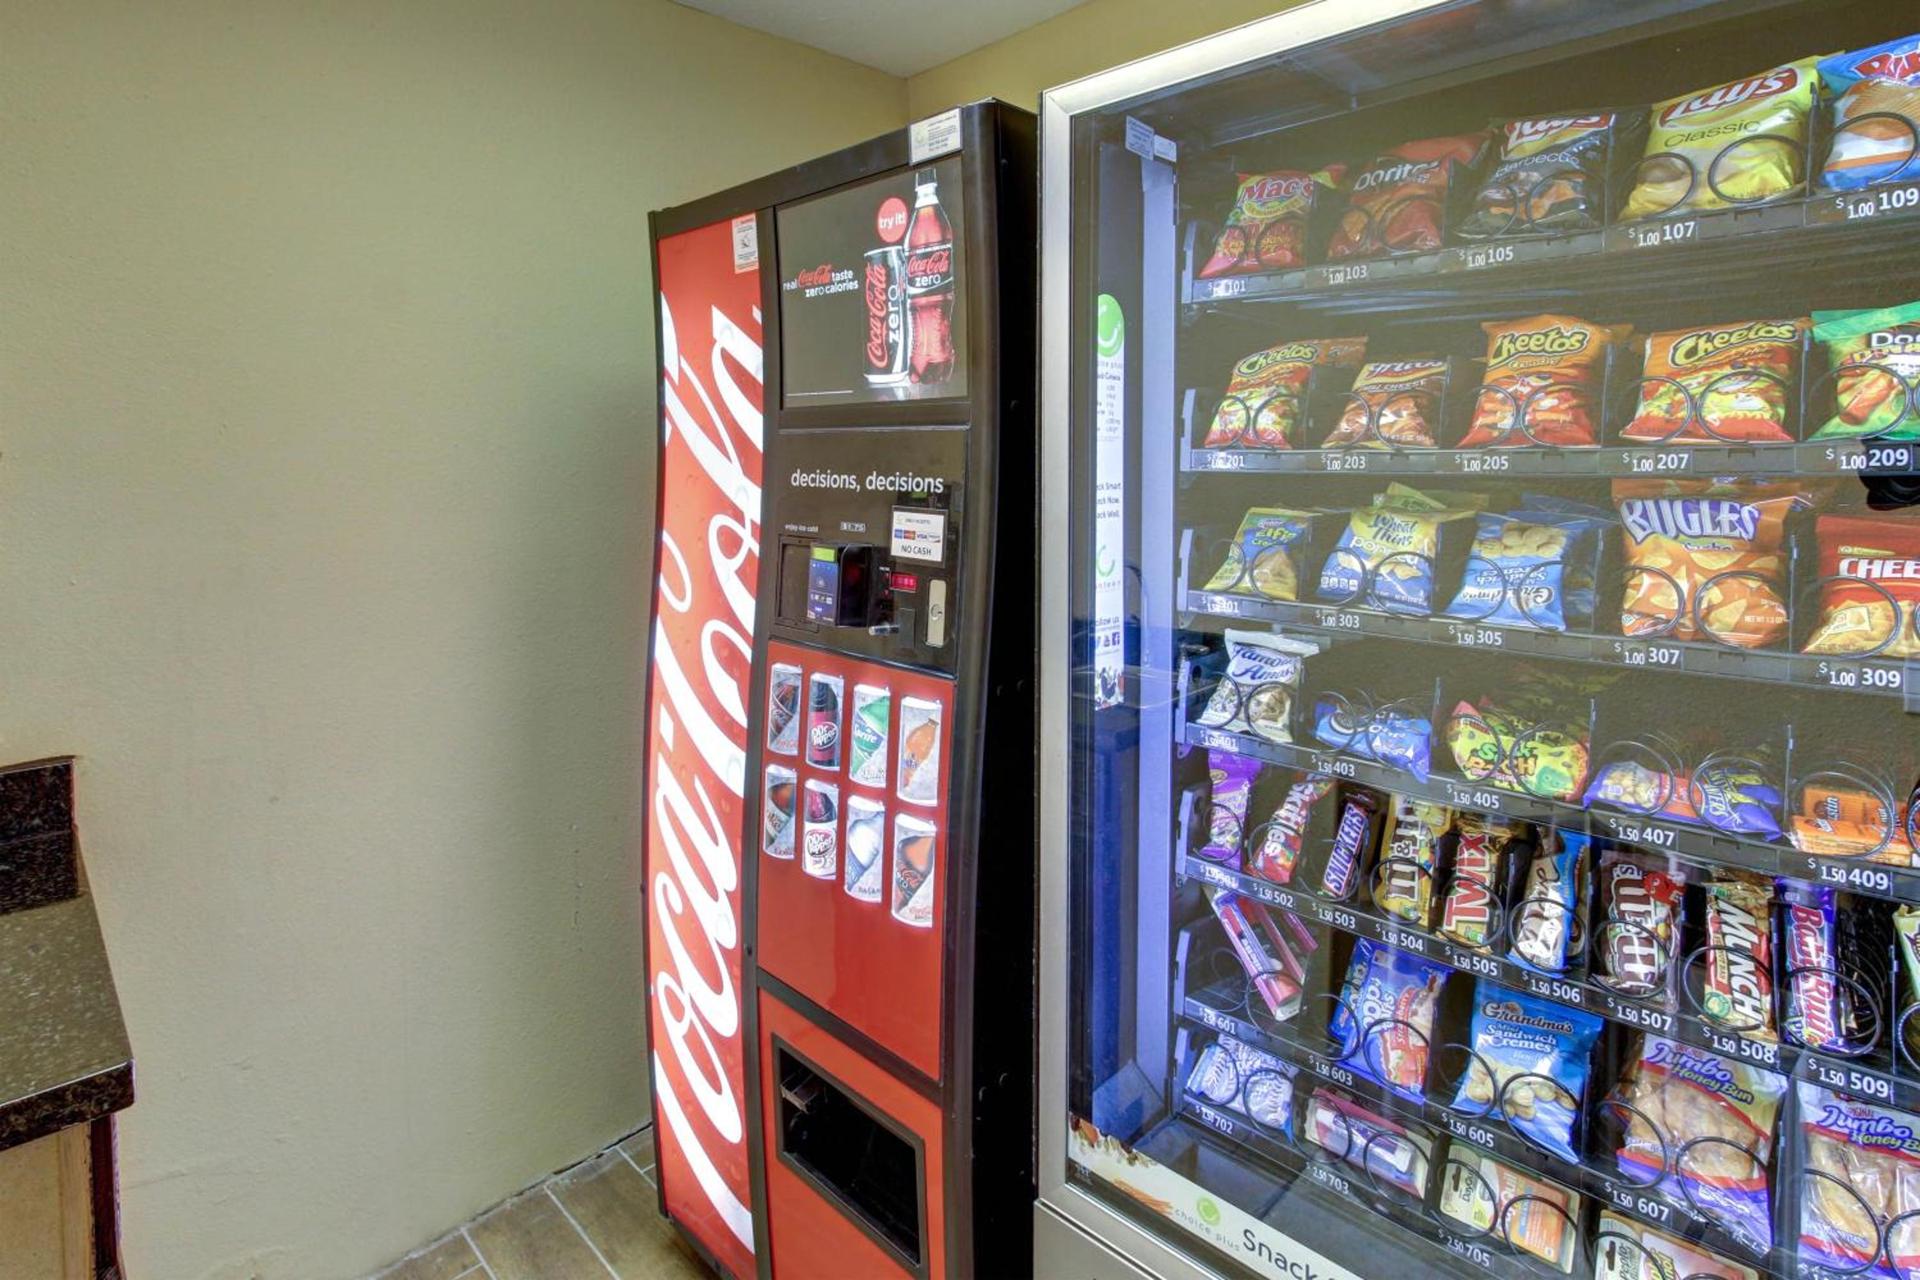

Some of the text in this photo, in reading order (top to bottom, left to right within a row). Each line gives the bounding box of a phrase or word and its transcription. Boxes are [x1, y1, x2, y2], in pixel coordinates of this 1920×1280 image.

[1664, 119, 1761, 148] Classic
[1847, 202, 1875, 219] 1.00
[1878, 188, 1919, 211] 109
[1638, 232, 1660, 246] 1.00
[1662, 222, 1696, 241] 107
[1467, 254, 1486, 267] 1.00
[1487, 246, 1514, 263] 105
[782, 278, 797, 290] real
[832, 270, 853, 281] taste
[915, 274, 941, 286] zero
[1345, 264, 1367, 279] 103
[805, 280, 859, 297] zero calories
[888, 285, 899, 343] zero
[1672, 323, 1796, 366] Cheetos
[1344, 455, 1366, 469] 203
[1463, 459, 1481, 472] 1.00
[1483, 456, 1509, 470] 205
[1632, 458, 1653, 472] 1.00
[1656, 453, 1689, 470] 207
[1840, 455, 1866, 470] 1.00
[1868, 448, 1909, 467] 209
[791, 469, 944, 493] decisions, decisions
[1620, 499, 1759, 544] BUGLES
[901, 545, 932, 556] NO CASH
[1339, 613, 1360, 628] 303
[1476, 630, 1503, 645] 305
[1624, 651, 1645, 666] 1.00
[1648, 648, 1680, 665] 307
[1829, 671, 1855, 687] 1.00
[1861, 668, 1900, 688] 309
[1333, 762, 1356, 777] 403
[1454, 792, 1470, 805] 1.50
[1473, 793, 1500, 809] 405
[1618, 827, 1640, 842] 1.50
[1642, 828, 1675, 847] 407
[1324, 803, 1366, 895] SNICKERS
[1443, 832, 1489, 932] TWIX
[1820, 865, 1847, 884] 1.50
[1848, 869, 1890, 890] 409
[1273, 891, 1293, 908] 502
[1334, 913, 1356, 929] 503
[1382, 932, 1398, 945] 1.50
[1400, 934, 1424, 951] 504
[1453, 955, 1470, 969] 1.50
[1472, 958, 1498, 976] 505
[1717, 898, 1765, 1025] MUNCH
[1531, 980, 1550, 995] 1.50
[1552, 983, 1581, 1003] 506
[1216, 1017, 1236, 1036] 601
[1483, 1002, 1574, 1033] Grandma's
[1617, 1005, 1638, 1022] 1.50
[1641, 1009, 1672, 1032] 507
[1487, 1024, 1556, 1045] Sandwich
[1712, 1035, 1736, 1053] 1.50
[1740, 1040, 1776, 1063] 508
[1647, 1042, 1732, 1082] Jumbo
[1331, 1064, 1353, 1086] 603
[1672, 1064, 1754, 1104] Honey Bun
[1819, 1067, 1845, 1086] 1.50
[1850, 1073, 1890, 1098] 509
[1214, 1114, 1233, 1134] 702
[1817, 1105, 1912, 1139] Jumbo
[1450, 1120, 1467, 1136] 1.50
[1468, 1125, 1495, 1147] 605
[1851, 1131, 1900, 1150] Honey
[1327, 1172, 1349, 1195] 703
[1612, 1190, 1633, 1209] 1.50
[1637, 1197, 1670, 1222] 607
[1465, 1243, 1490, 1267] 705
